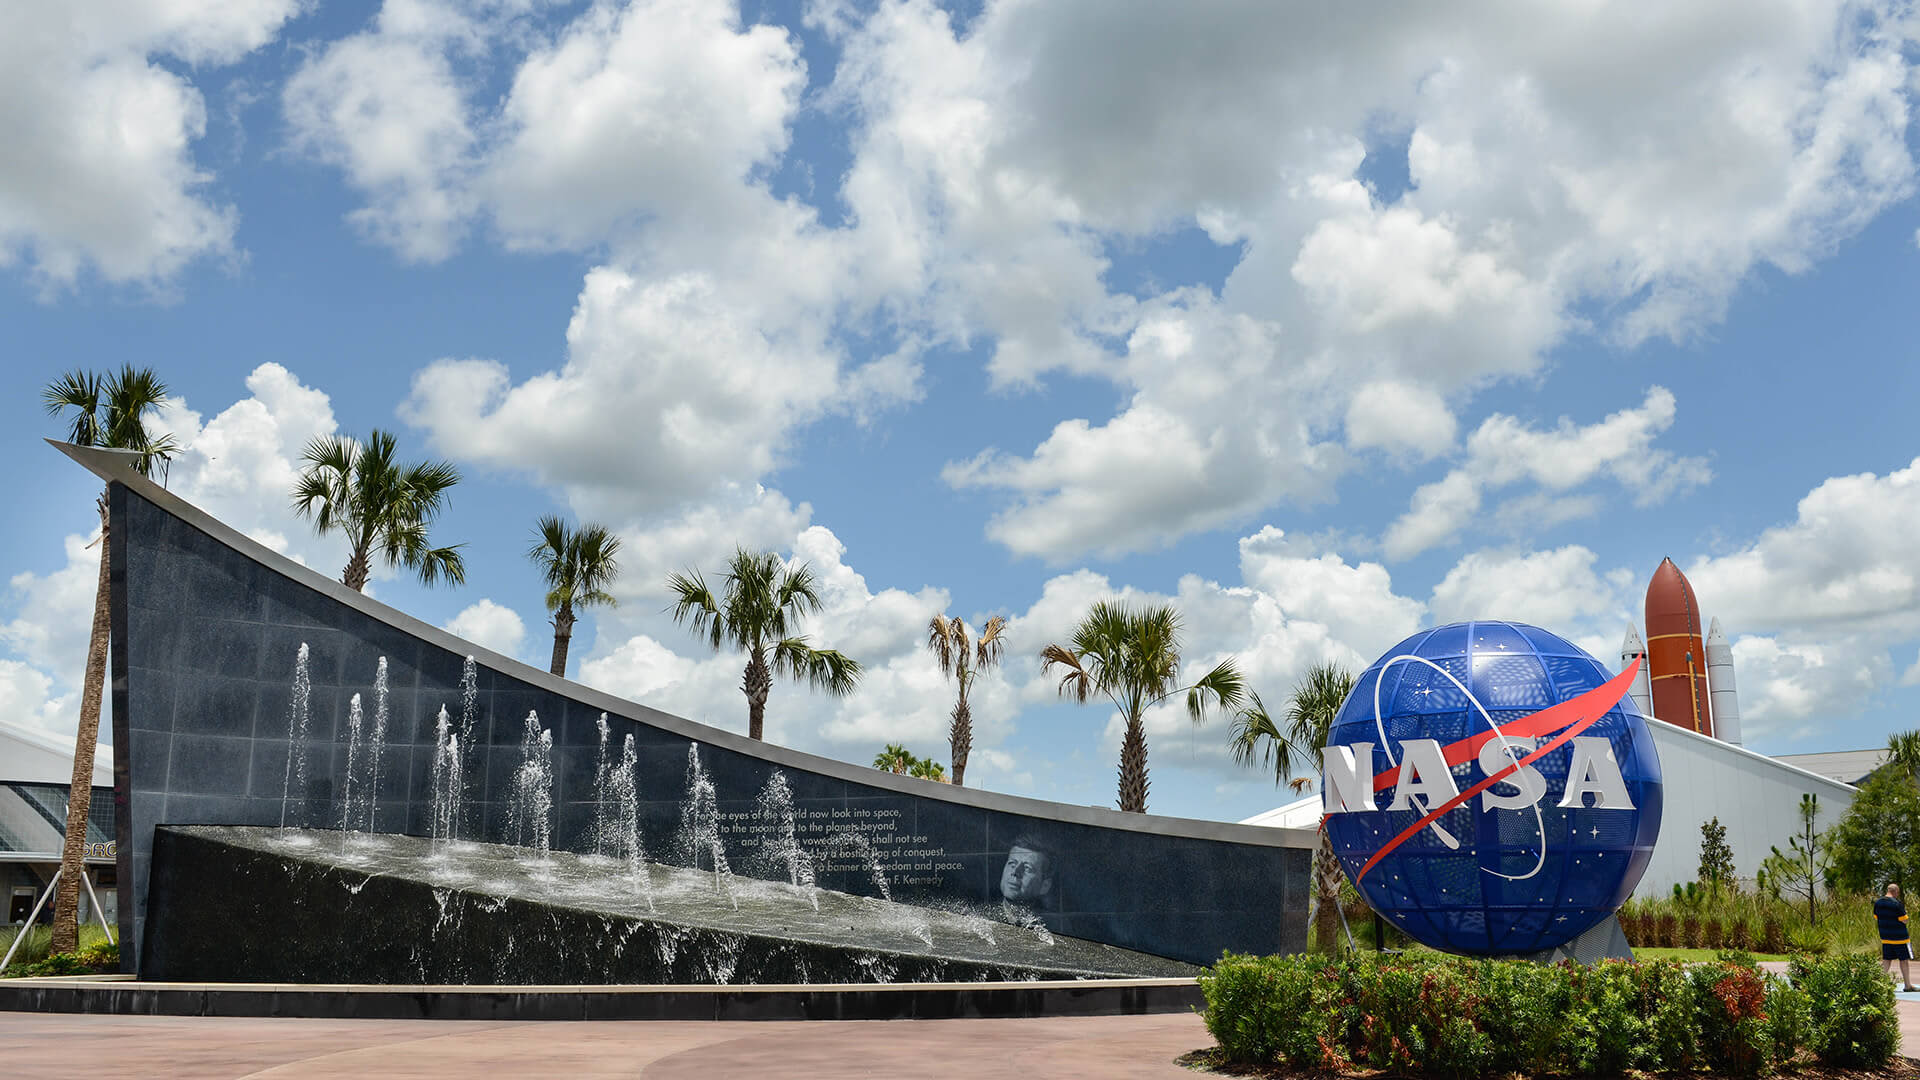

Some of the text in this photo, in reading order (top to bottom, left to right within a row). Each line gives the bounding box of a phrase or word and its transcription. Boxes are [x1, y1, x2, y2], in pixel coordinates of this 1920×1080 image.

[1320, 734, 1637, 814] NASA
[728, 813, 749, 822] eyes
[751, 809, 762, 820] of
[781, 808, 807, 819] orld
[831, 807, 851, 818] look
[854, 808, 871, 818] into
[873, 809, 902, 820] space,
[721, 824, 730, 833] to
[732, 823, 747, 833] the
[749, 825, 775, 833] moon
[798, 823, 807, 832] to
[809, 821, 823, 832] the
[826, 821, 858, 834] planets
[861, 819, 898, 833] beyond,
[741, 835, 759, 846] and
[872, 833, 893, 844] shall
[895, 834, 910, 844] not
[912, 835, 928, 843] see
[816, 848, 828, 861] by
[840, 846, 869, 858] hostile
[891, 846, 901, 857] of
[903, 847, 946, 859] conquest,
[827, 861, 859, 872] banner
[874, 860, 911, 871] eedom
[914, 860, 932, 870] and
[934, 862, 965, 873] peace.
[894, 874, 901, 885] F.
[903, 873, 944, 887] Kennedy
